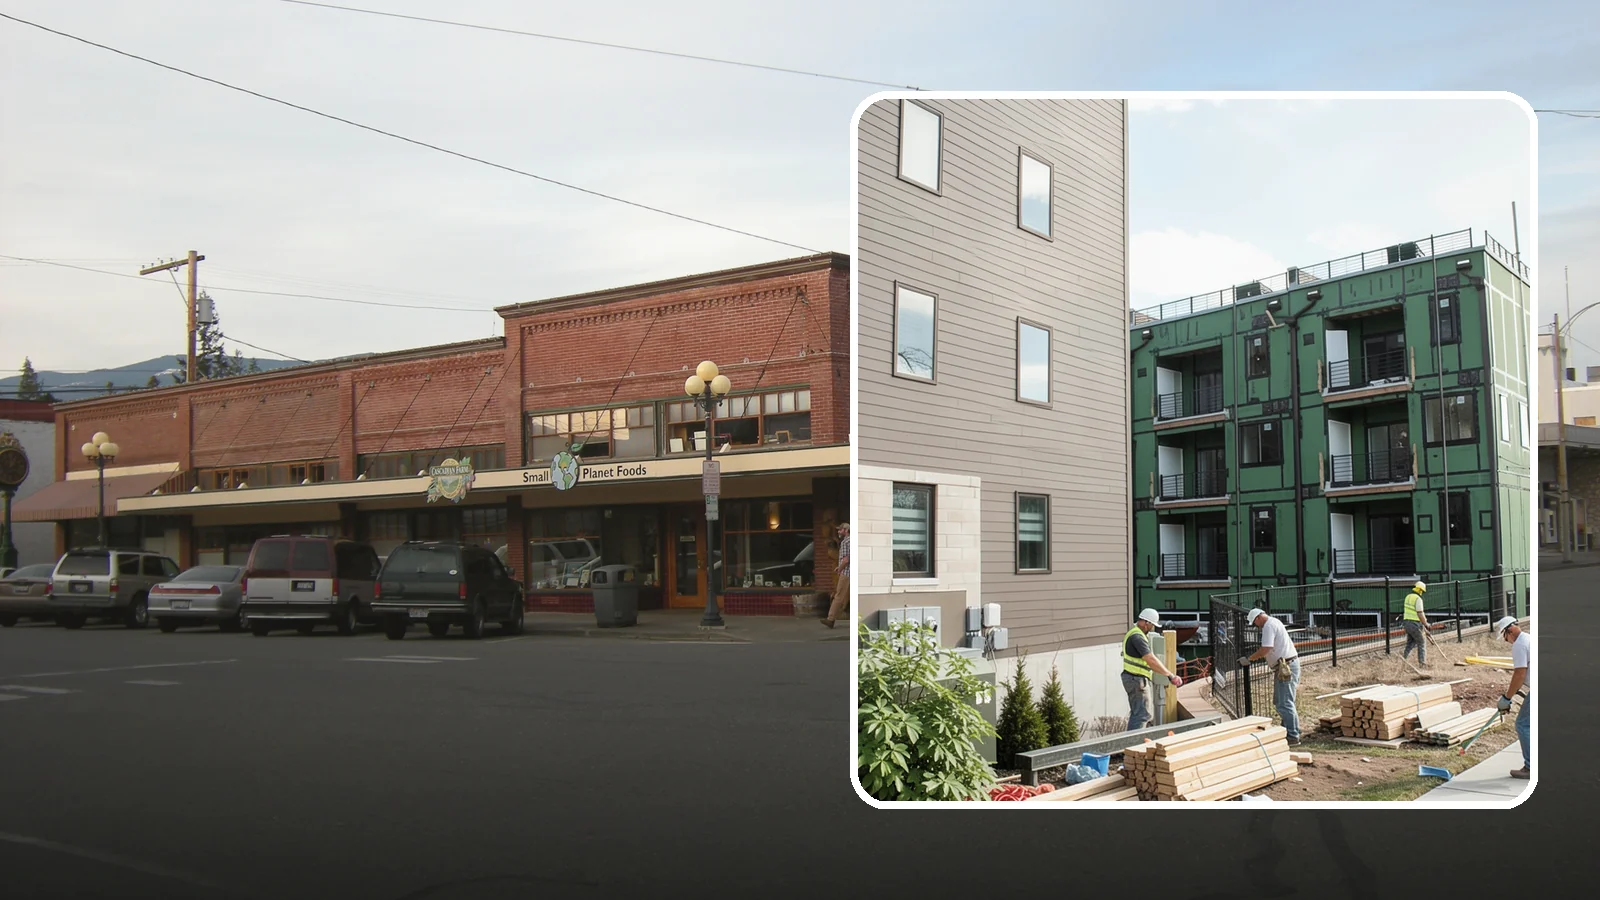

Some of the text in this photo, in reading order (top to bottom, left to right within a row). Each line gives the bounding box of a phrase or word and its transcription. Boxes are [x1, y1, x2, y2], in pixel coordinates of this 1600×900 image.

[523, 464, 647, 482] Small Planet Foods
